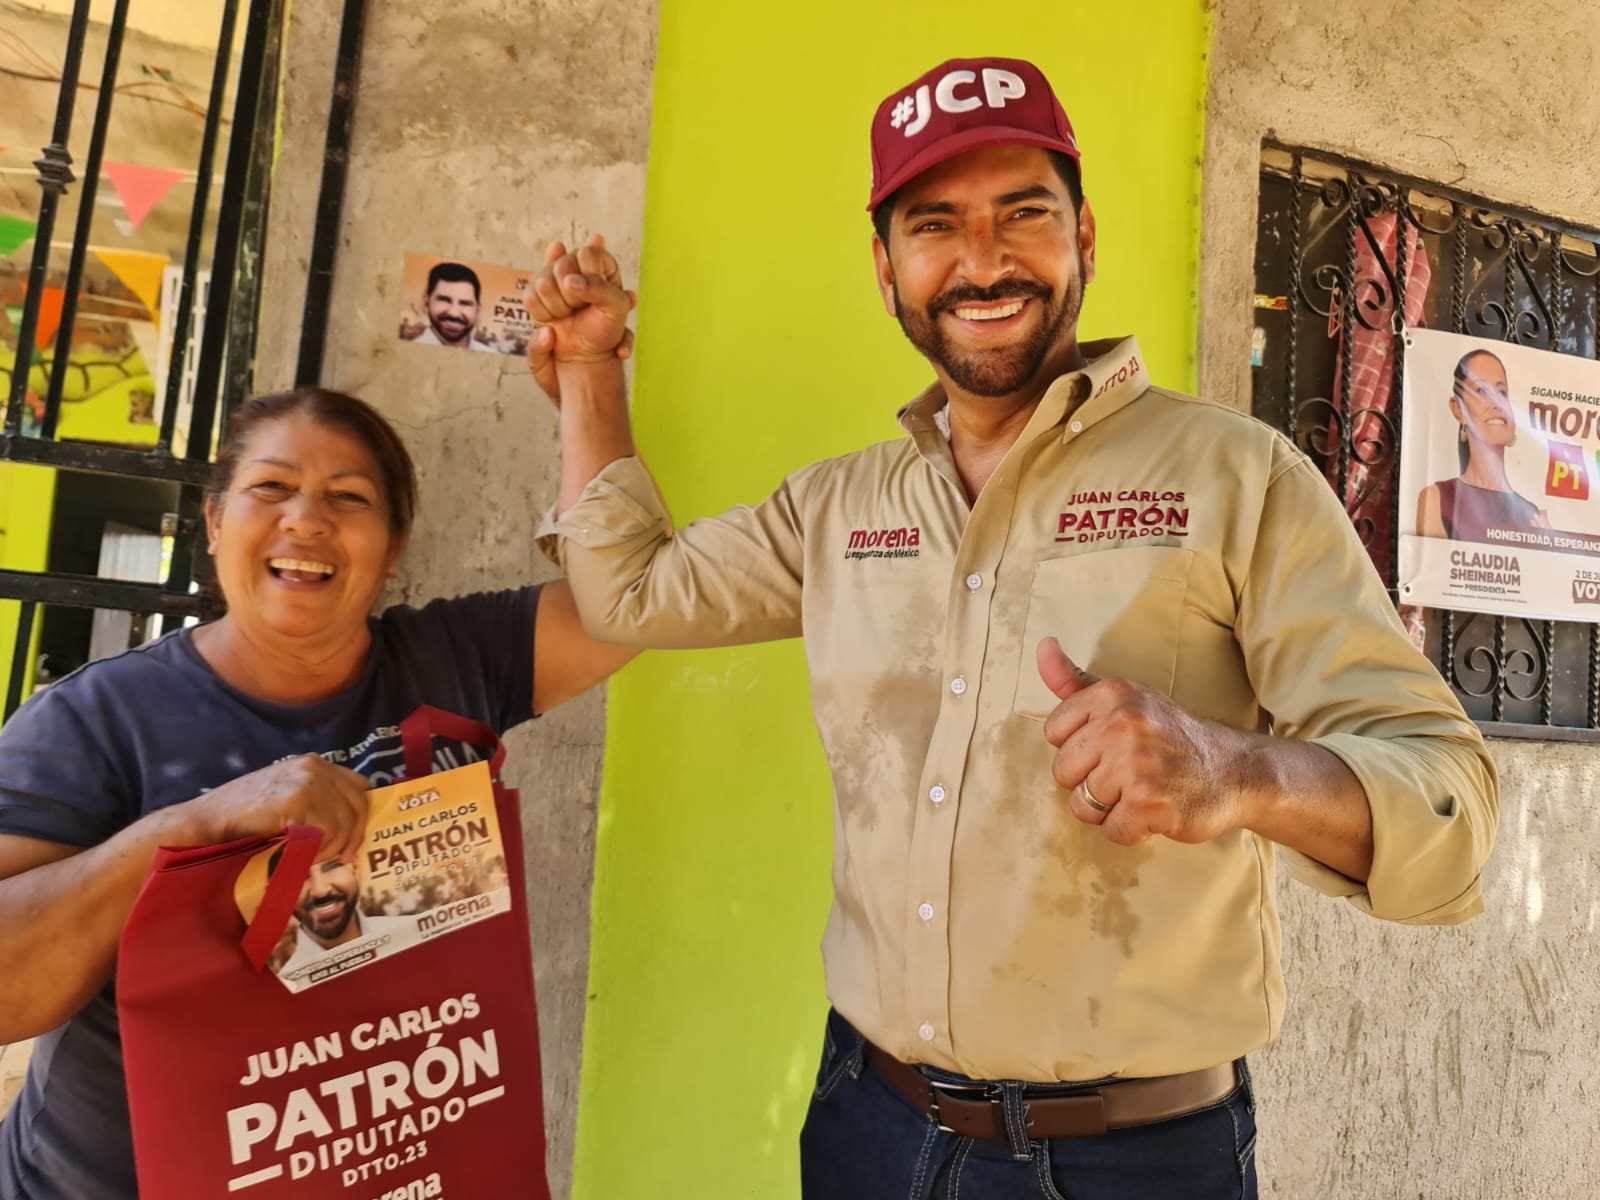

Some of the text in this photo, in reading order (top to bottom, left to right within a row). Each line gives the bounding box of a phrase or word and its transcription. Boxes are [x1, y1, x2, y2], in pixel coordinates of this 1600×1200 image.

[891, 67, 1026, 138] #JCP
[1529, 386, 1573, 401] SIGAMOS
[1551, 460, 1583, 491] PT
[1067, 489, 1185, 506] JUAN CARLOS
[1058, 502, 1189, 534] PATRÓN
[847, 527, 920, 549] morena
[1078, 526, 1164, 544] DIPUTADO
[1486, 527, 1553, 548] HONESTIDAD,
[1450, 550, 1521, 573] CLAUDIA
[1450, 567, 1521, 587] SHEINBAUM
[1582, 570, 1593, 580] DE
[1464, 583, 1506, 595] PRESIDENTA
[399, 790, 440, 810] VOTA
[372, 802, 479, 843] JUAN CARLOS
[367, 816, 489, 873] PATRÓN
[394, 844, 472, 876] DIPUTADO
[416, 895, 492, 932] morena
[239, 992, 481, 1086] JUAN CARLOS
[226, 1028, 501, 1166] PATRÓN
[288, 1096, 466, 1180] DIPUTADO
[341, 1139, 428, 1188] DTTO.23
